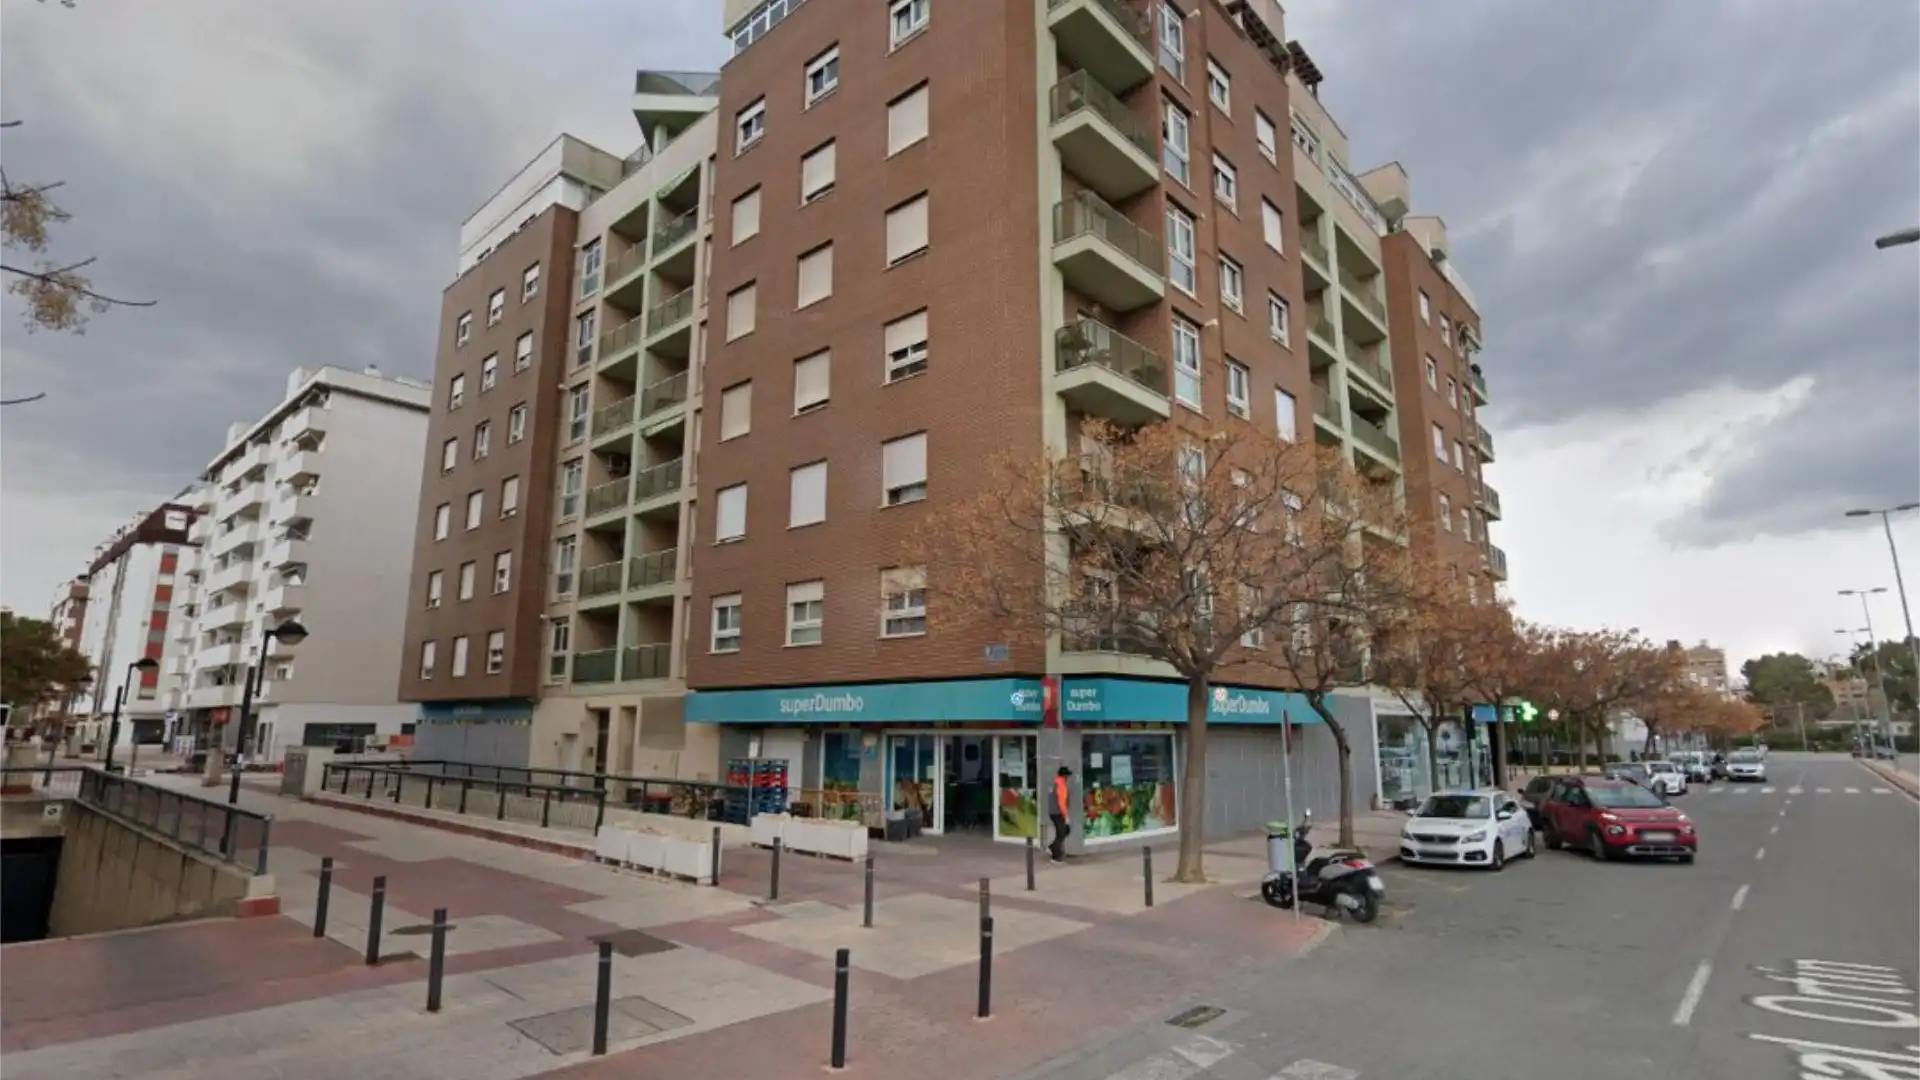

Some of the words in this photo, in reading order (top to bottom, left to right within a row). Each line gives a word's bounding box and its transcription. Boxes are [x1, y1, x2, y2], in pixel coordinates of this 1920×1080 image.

[1070, 688, 1097, 699] super
[779, 692, 864, 717] superDumbo
[1066, 700, 1102, 712] Dumbo
